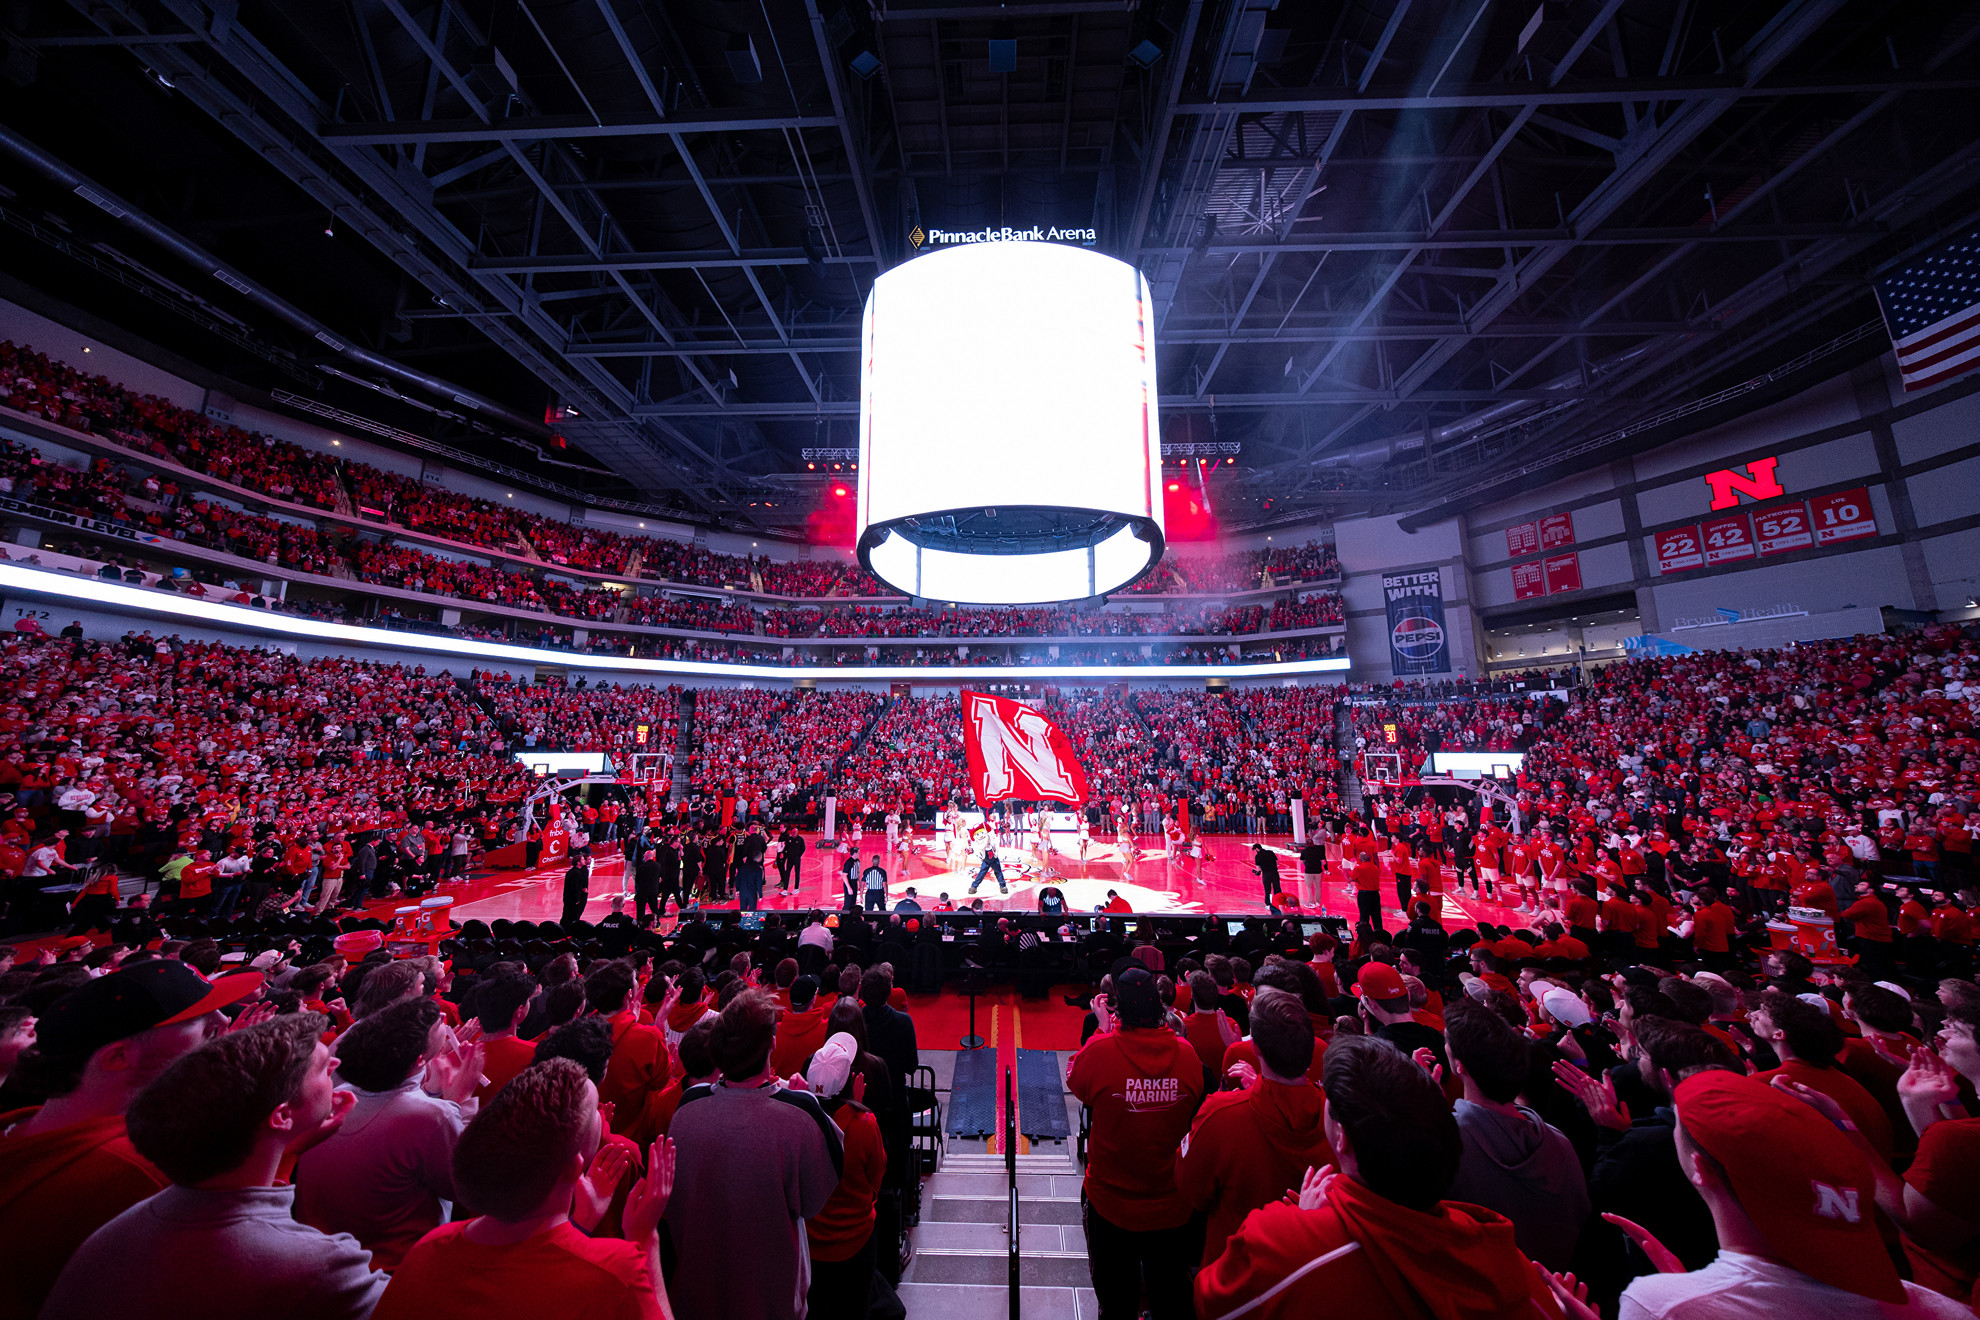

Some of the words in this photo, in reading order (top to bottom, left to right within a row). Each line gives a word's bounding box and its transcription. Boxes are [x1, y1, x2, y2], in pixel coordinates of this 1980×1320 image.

[929, 226, 1043, 244] PinnacleBank
[1046, 227, 1096, 241] Arena
[1705, 456, 1784, 511] N
[1823, 504, 1860, 525] 10
[81, 518, 140, 540] LEVEL
[1710, 523, 1737, 532] HOPPEN
[1763, 516, 1802, 536] 52
[1708, 528, 1744, 547] 42
[1821, 530, 1835, 539] N
[1661, 538, 1695, 557] 22
[1383, 572, 1439, 588] BETTER
[1387, 584, 1438, 602] WITH
[1674, 614, 1724, 627] Bryan
[1743, 603, 1799, 620] Health
[1395, 632, 1440, 643] PEPSI
[637, 732, 647, 743] 30
[1386, 731, 1397, 742] 30
[971, 696, 1080, 801] N
[549, 829, 564, 838] fnbo
[542, 853, 565, 864] Channel
[396, 917, 404, 925] G
[421, 911, 431, 922] G
[1421, 927, 1440, 935] POLICE
[1823, 929, 1836, 942] G
[1790, 936, 1799, 944] G
[815, 1084, 824, 1093] N
[1126, 1078, 1178, 1090] PARKER
[1125, 1090, 1178, 1102] MARINE
[1811, 1180, 1860, 1223] N
